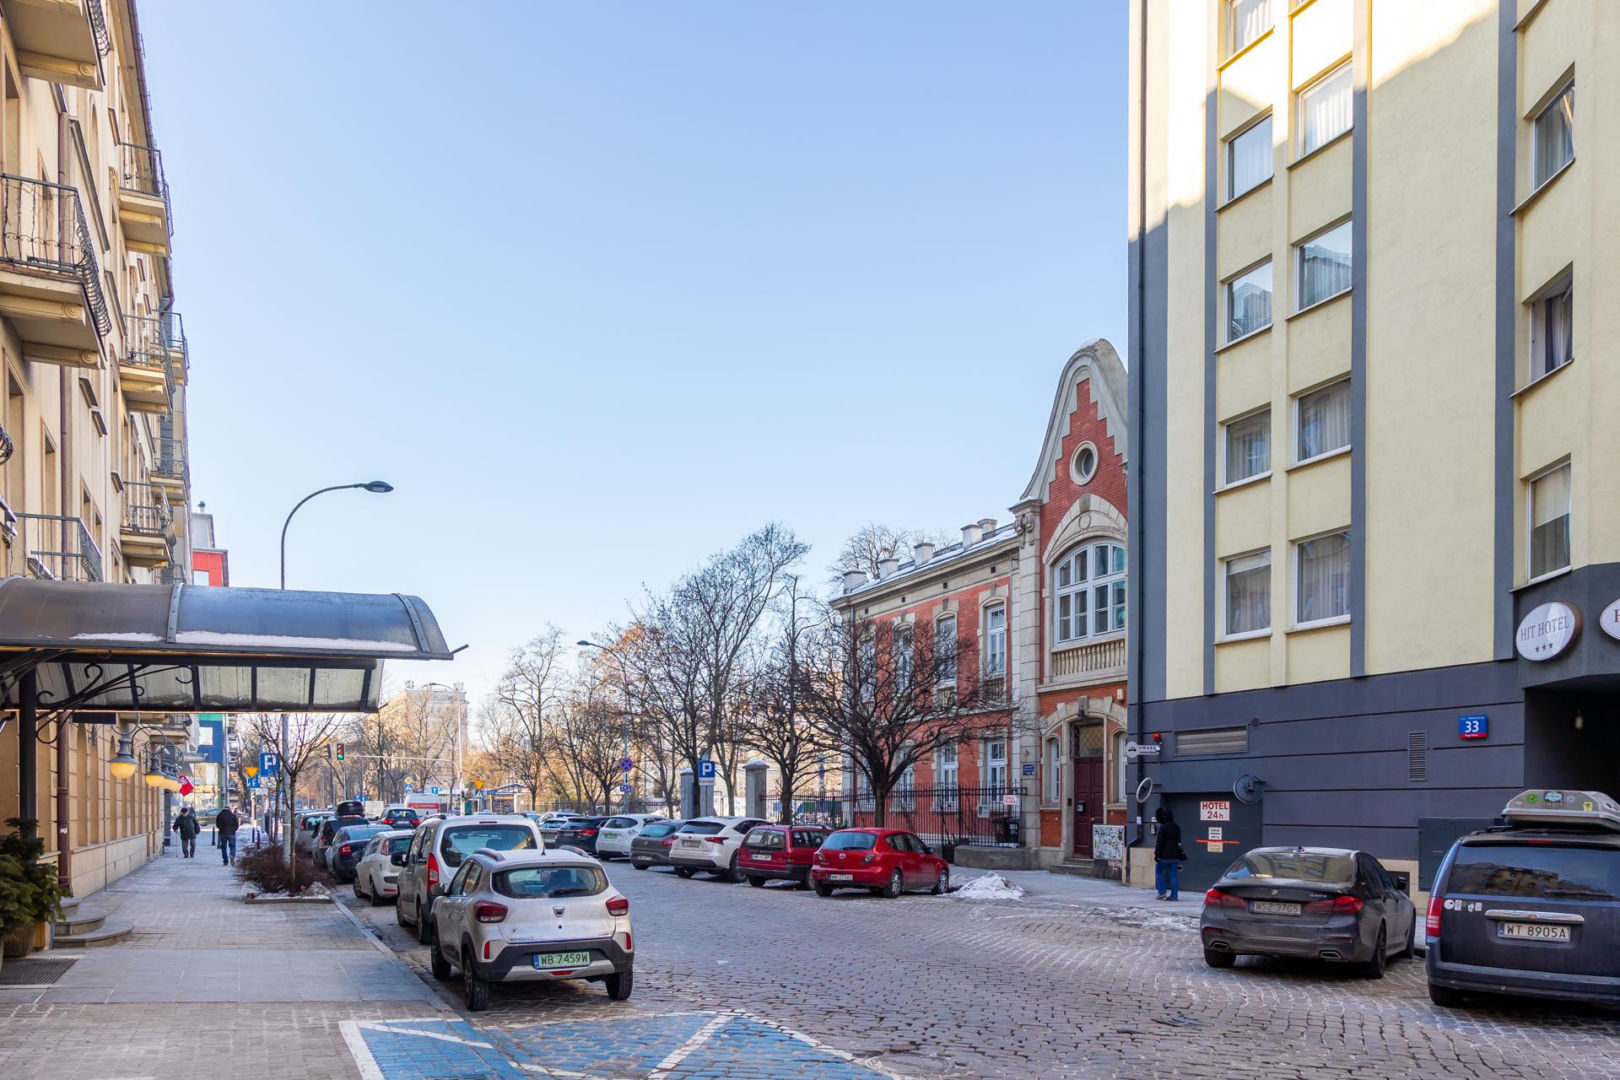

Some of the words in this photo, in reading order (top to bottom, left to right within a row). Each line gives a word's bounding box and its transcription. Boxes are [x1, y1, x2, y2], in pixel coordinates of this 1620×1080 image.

[1520, 625, 1536, 641] HIT
[1538, 615, 1570, 637] HOTEL
[1464, 720, 1480, 733] 33
[263, 754, 277, 770] P
[702, 762, 712, 776] P
[1202, 802, 1228, 810] HOTEL
[1507, 925, 1523, 935] WT
[1527, 925, 1567, 939] 8905A
[540, 955, 554, 965] WB
[557, 953, 588, 964] 7459W
